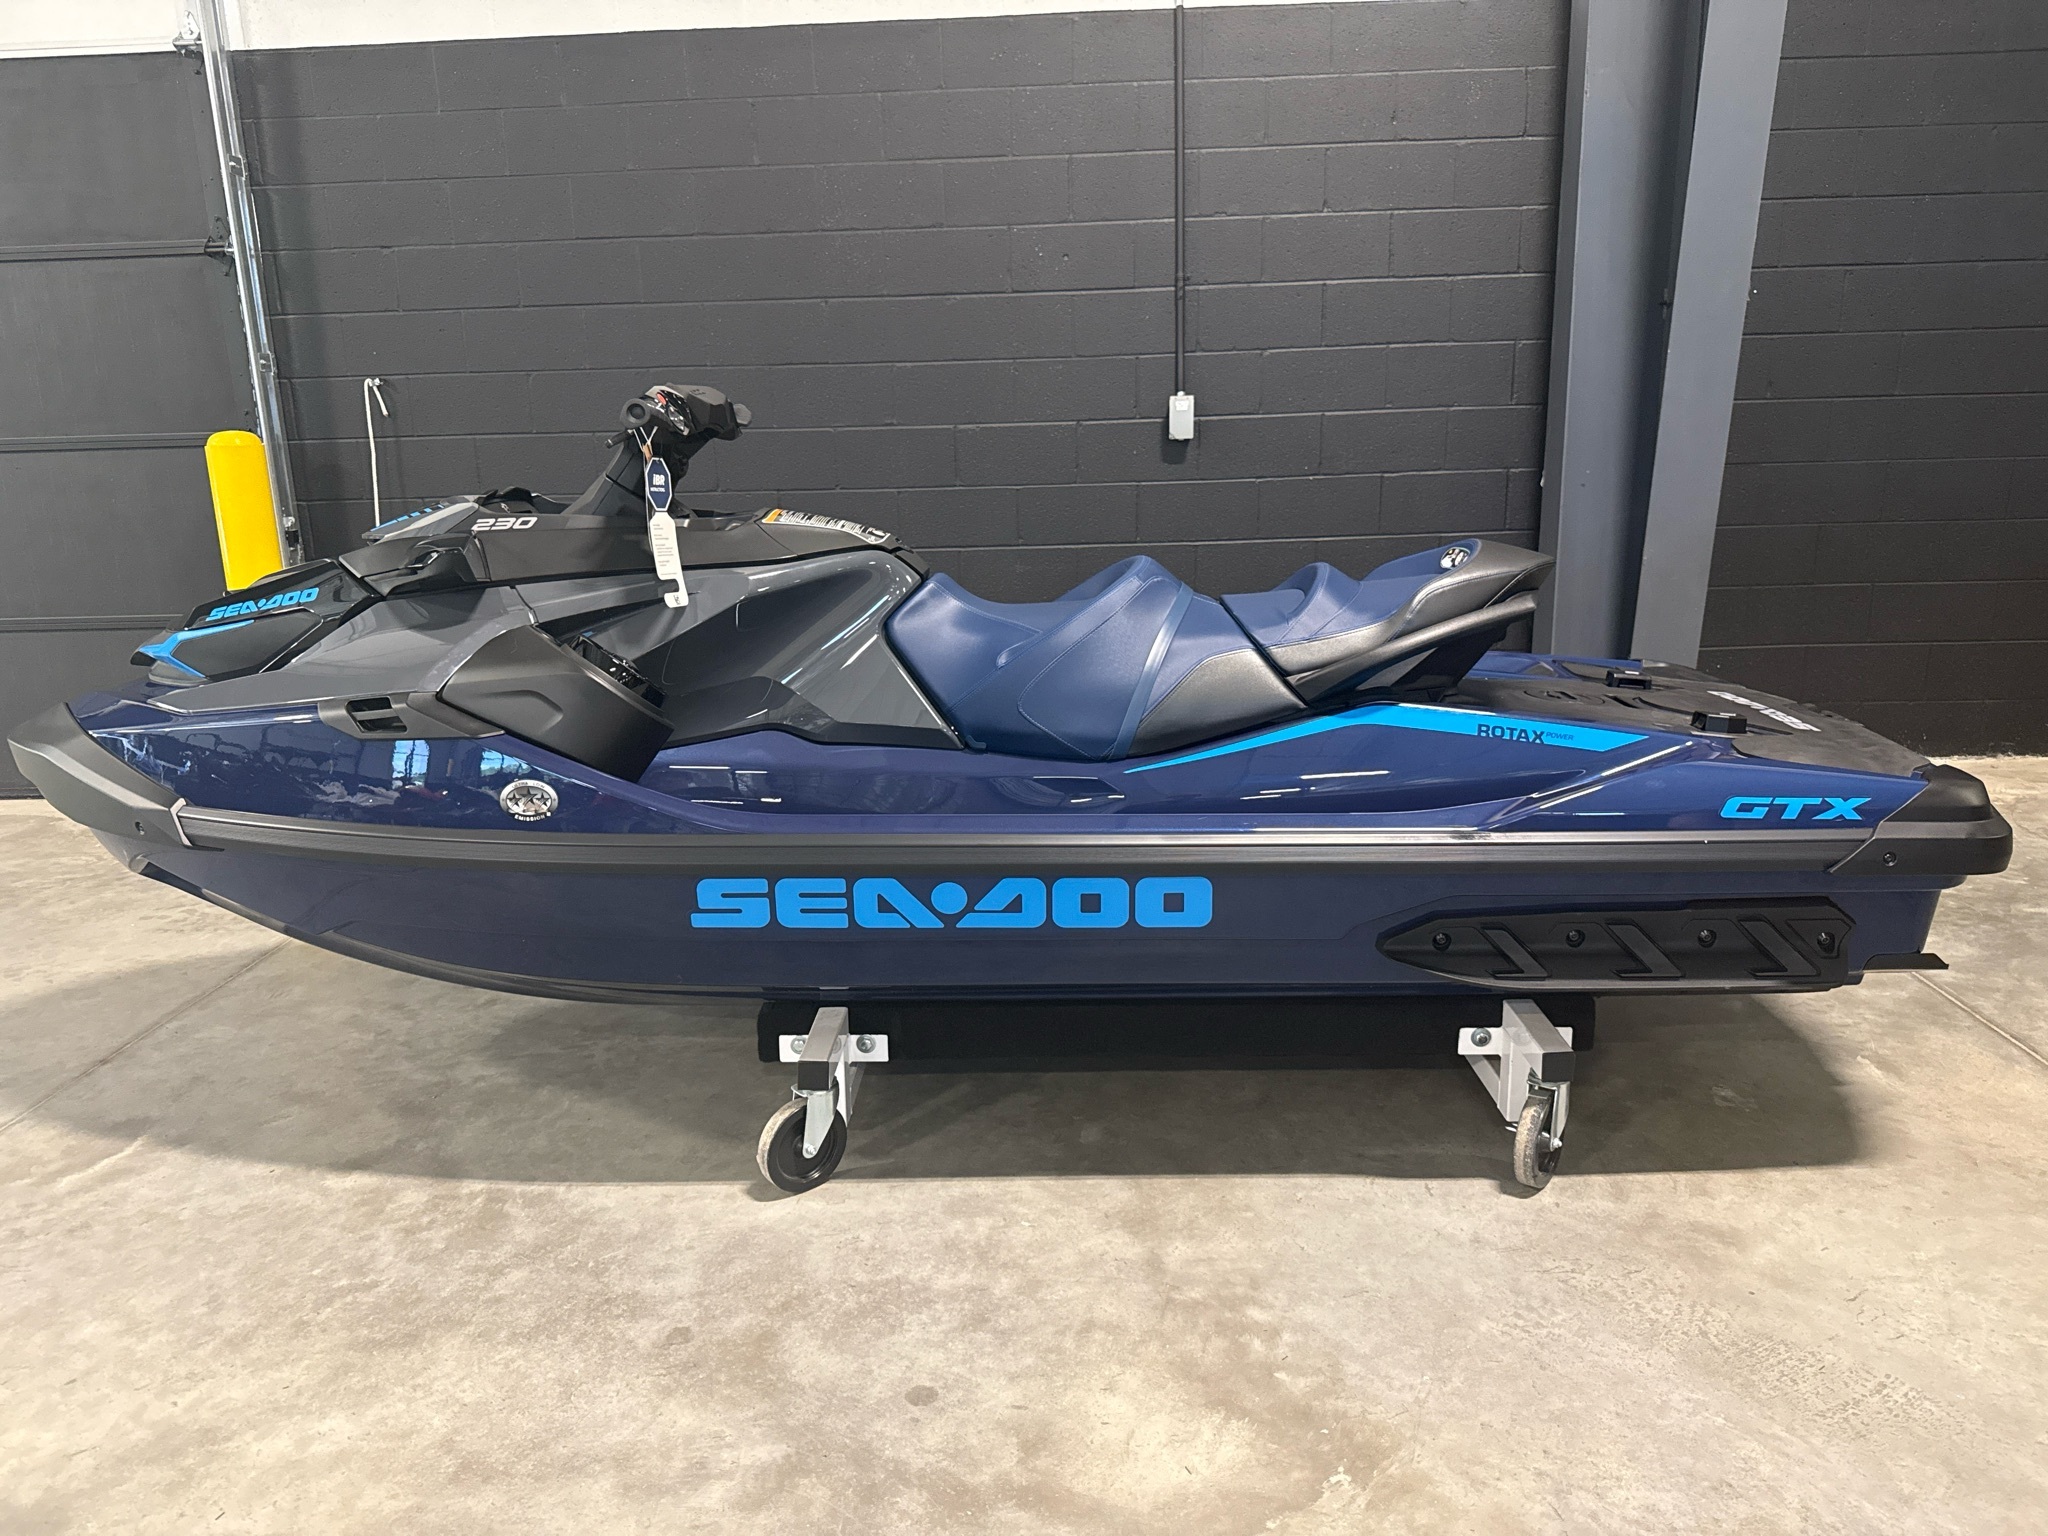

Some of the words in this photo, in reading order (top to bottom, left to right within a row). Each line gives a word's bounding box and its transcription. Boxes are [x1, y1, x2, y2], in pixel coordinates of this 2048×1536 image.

[653, 474, 665, 486] iBR
[471, 516, 538, 531] 230
[1477, 723, 1545, 744] ROTAX
[1546, 732, 1574, 741] POWER
[1720, 796, 1872, 820] GTX
